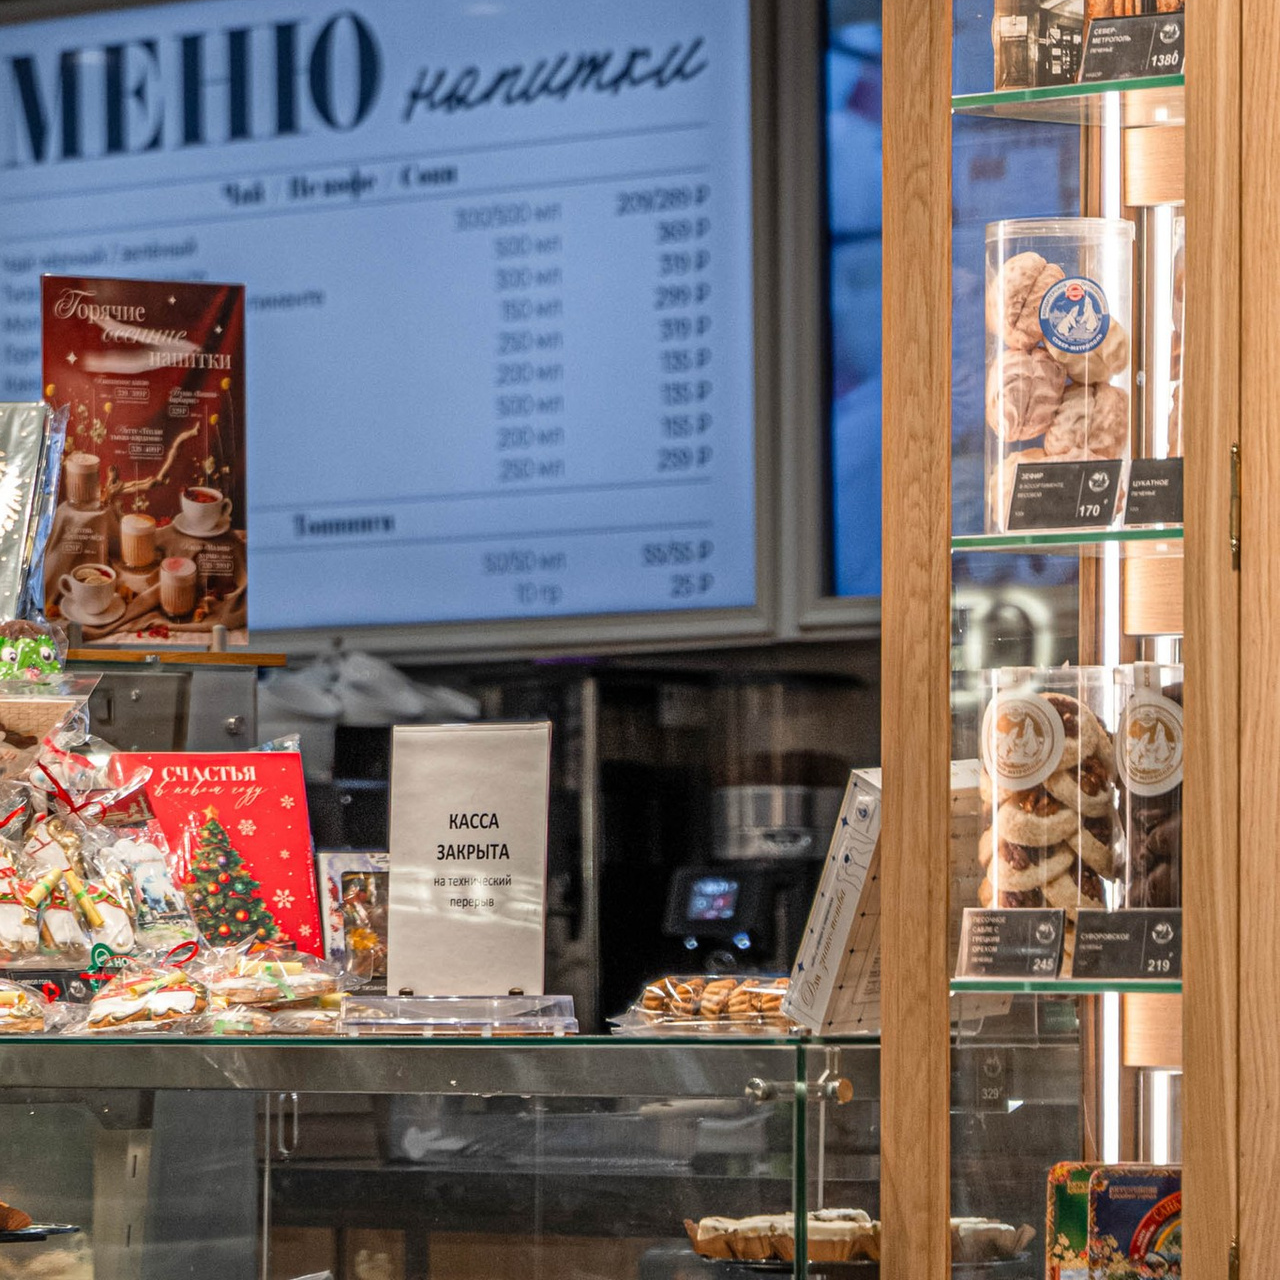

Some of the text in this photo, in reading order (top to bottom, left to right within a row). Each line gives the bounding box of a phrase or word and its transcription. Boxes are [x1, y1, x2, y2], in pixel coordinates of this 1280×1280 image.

[3, 9, 709, 170] МЕНЮ напитки
[55, 288, 145, 324] Горячие
[149, 350, 232, 370] напитки
[1132, 479, 1169, 487] ЦУКАТНОЕ
[1079, 504, 1100, 518] 170
[161, 765, 257, 782] СЧАСТЬЯ
[449, 813, 499, 830] КАССА
[436, 844, 510, 861] ЗАКРЫТА
[434, 874, 511, 887] на технический
[449, 897, 495, 908] перерыв
[1033, 958, 1054, 971] 245
[1147, 959, 1170, 972] 219
